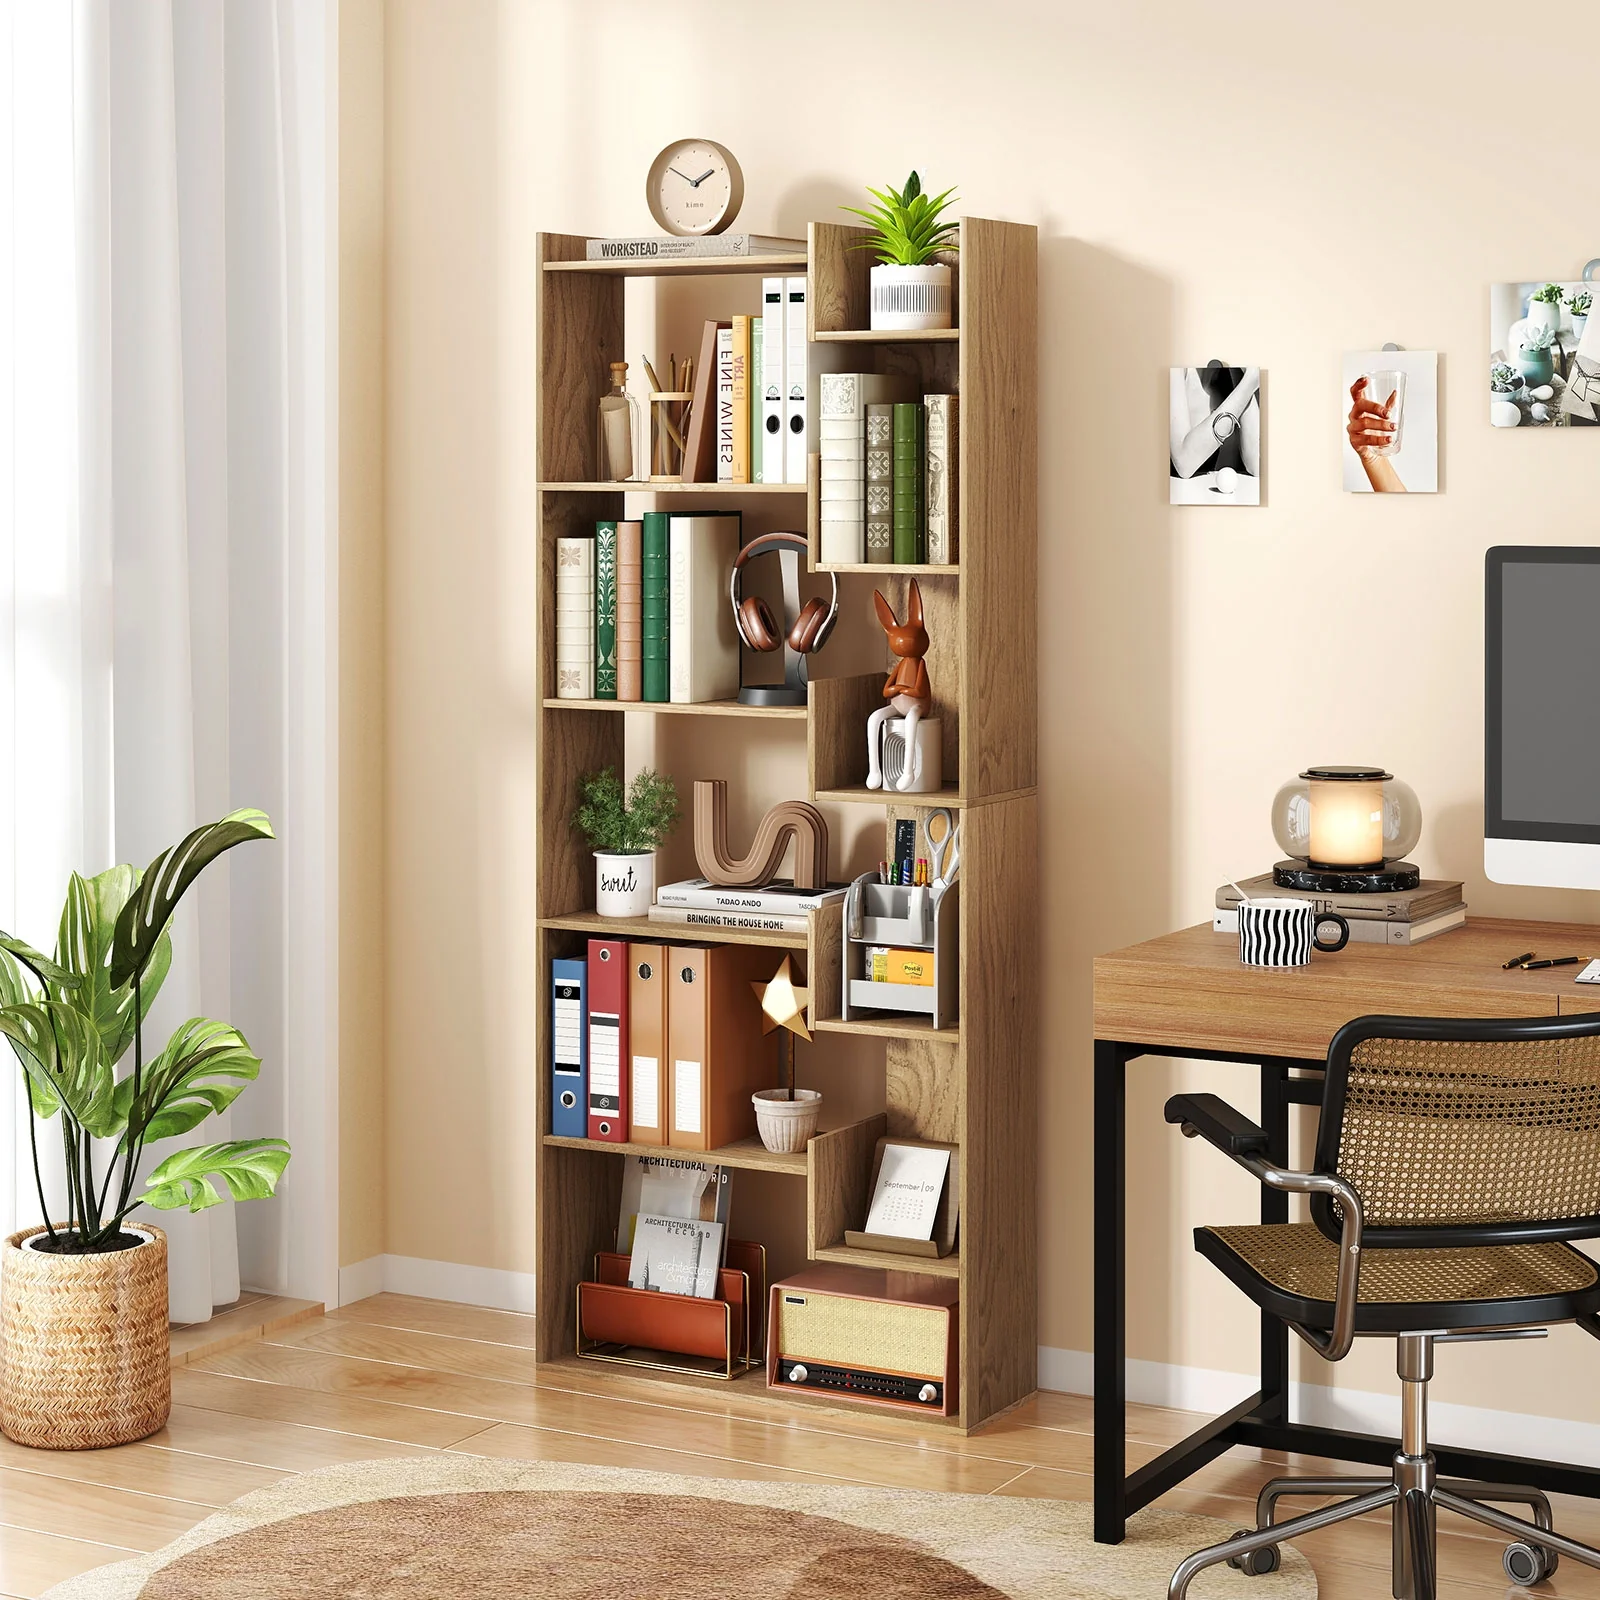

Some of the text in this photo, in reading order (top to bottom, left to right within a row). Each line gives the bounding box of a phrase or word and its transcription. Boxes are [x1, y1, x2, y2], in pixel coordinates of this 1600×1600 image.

[601, 242, 658, 257] WORKSTEAD
[673, 551, 685, 625] LUXDECO
[716, 897, 741, 906] TADAO
[741, 899, 762, 908] ANDO
[686, 913, 784, 930] BRINGING THE HOUSE HOME
[638, 1156, 707, 1172] ARCHITECTURAL
[669, 1169, 728, 1184] REORD
[884, 1180, 935, 1193] September 09
[644, 1217, 696, 1230] ARCHITECTURAL
[667, 1228, 711, 1239] RECORD
[657, 1255, 713, 1277] architecture
